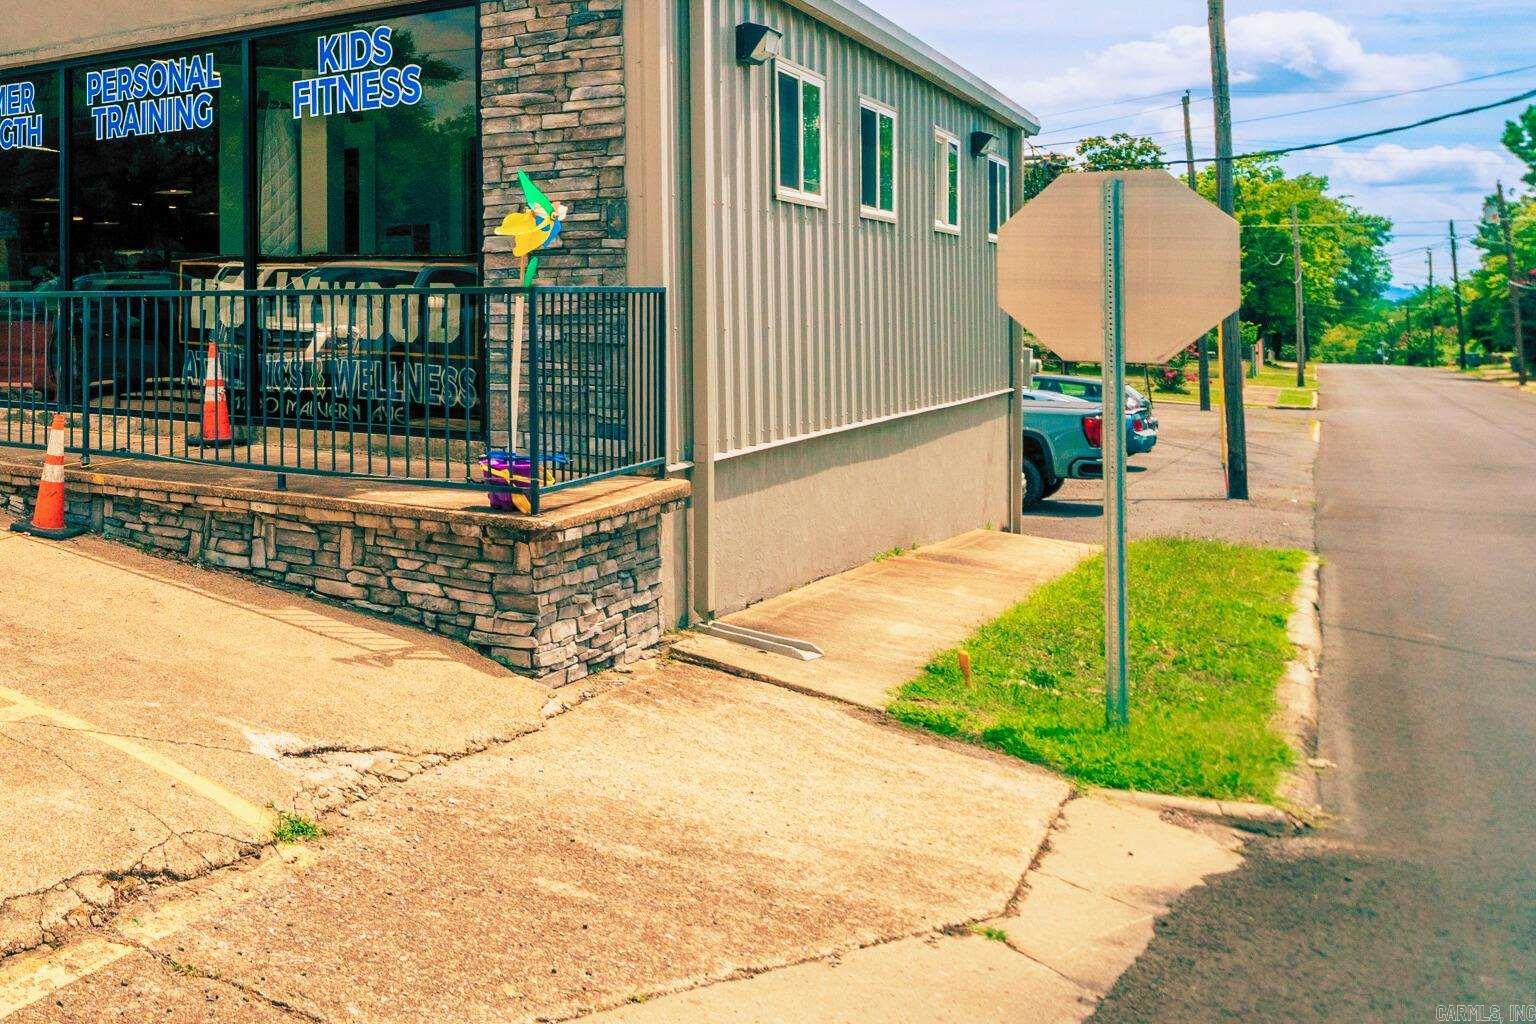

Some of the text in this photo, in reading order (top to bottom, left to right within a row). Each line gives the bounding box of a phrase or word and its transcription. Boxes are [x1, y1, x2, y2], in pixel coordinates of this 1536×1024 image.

[317, 25, 394, 75] KIDS
[86, 53, 221, 106] PERSONAL
[292, 63, 423, 119] FITNESS
[92, 92, 213, 141] TRAINING
[191, 271, 461, 343] HOLYWOOD
[332, 360, 478, 409] WELLNESS
